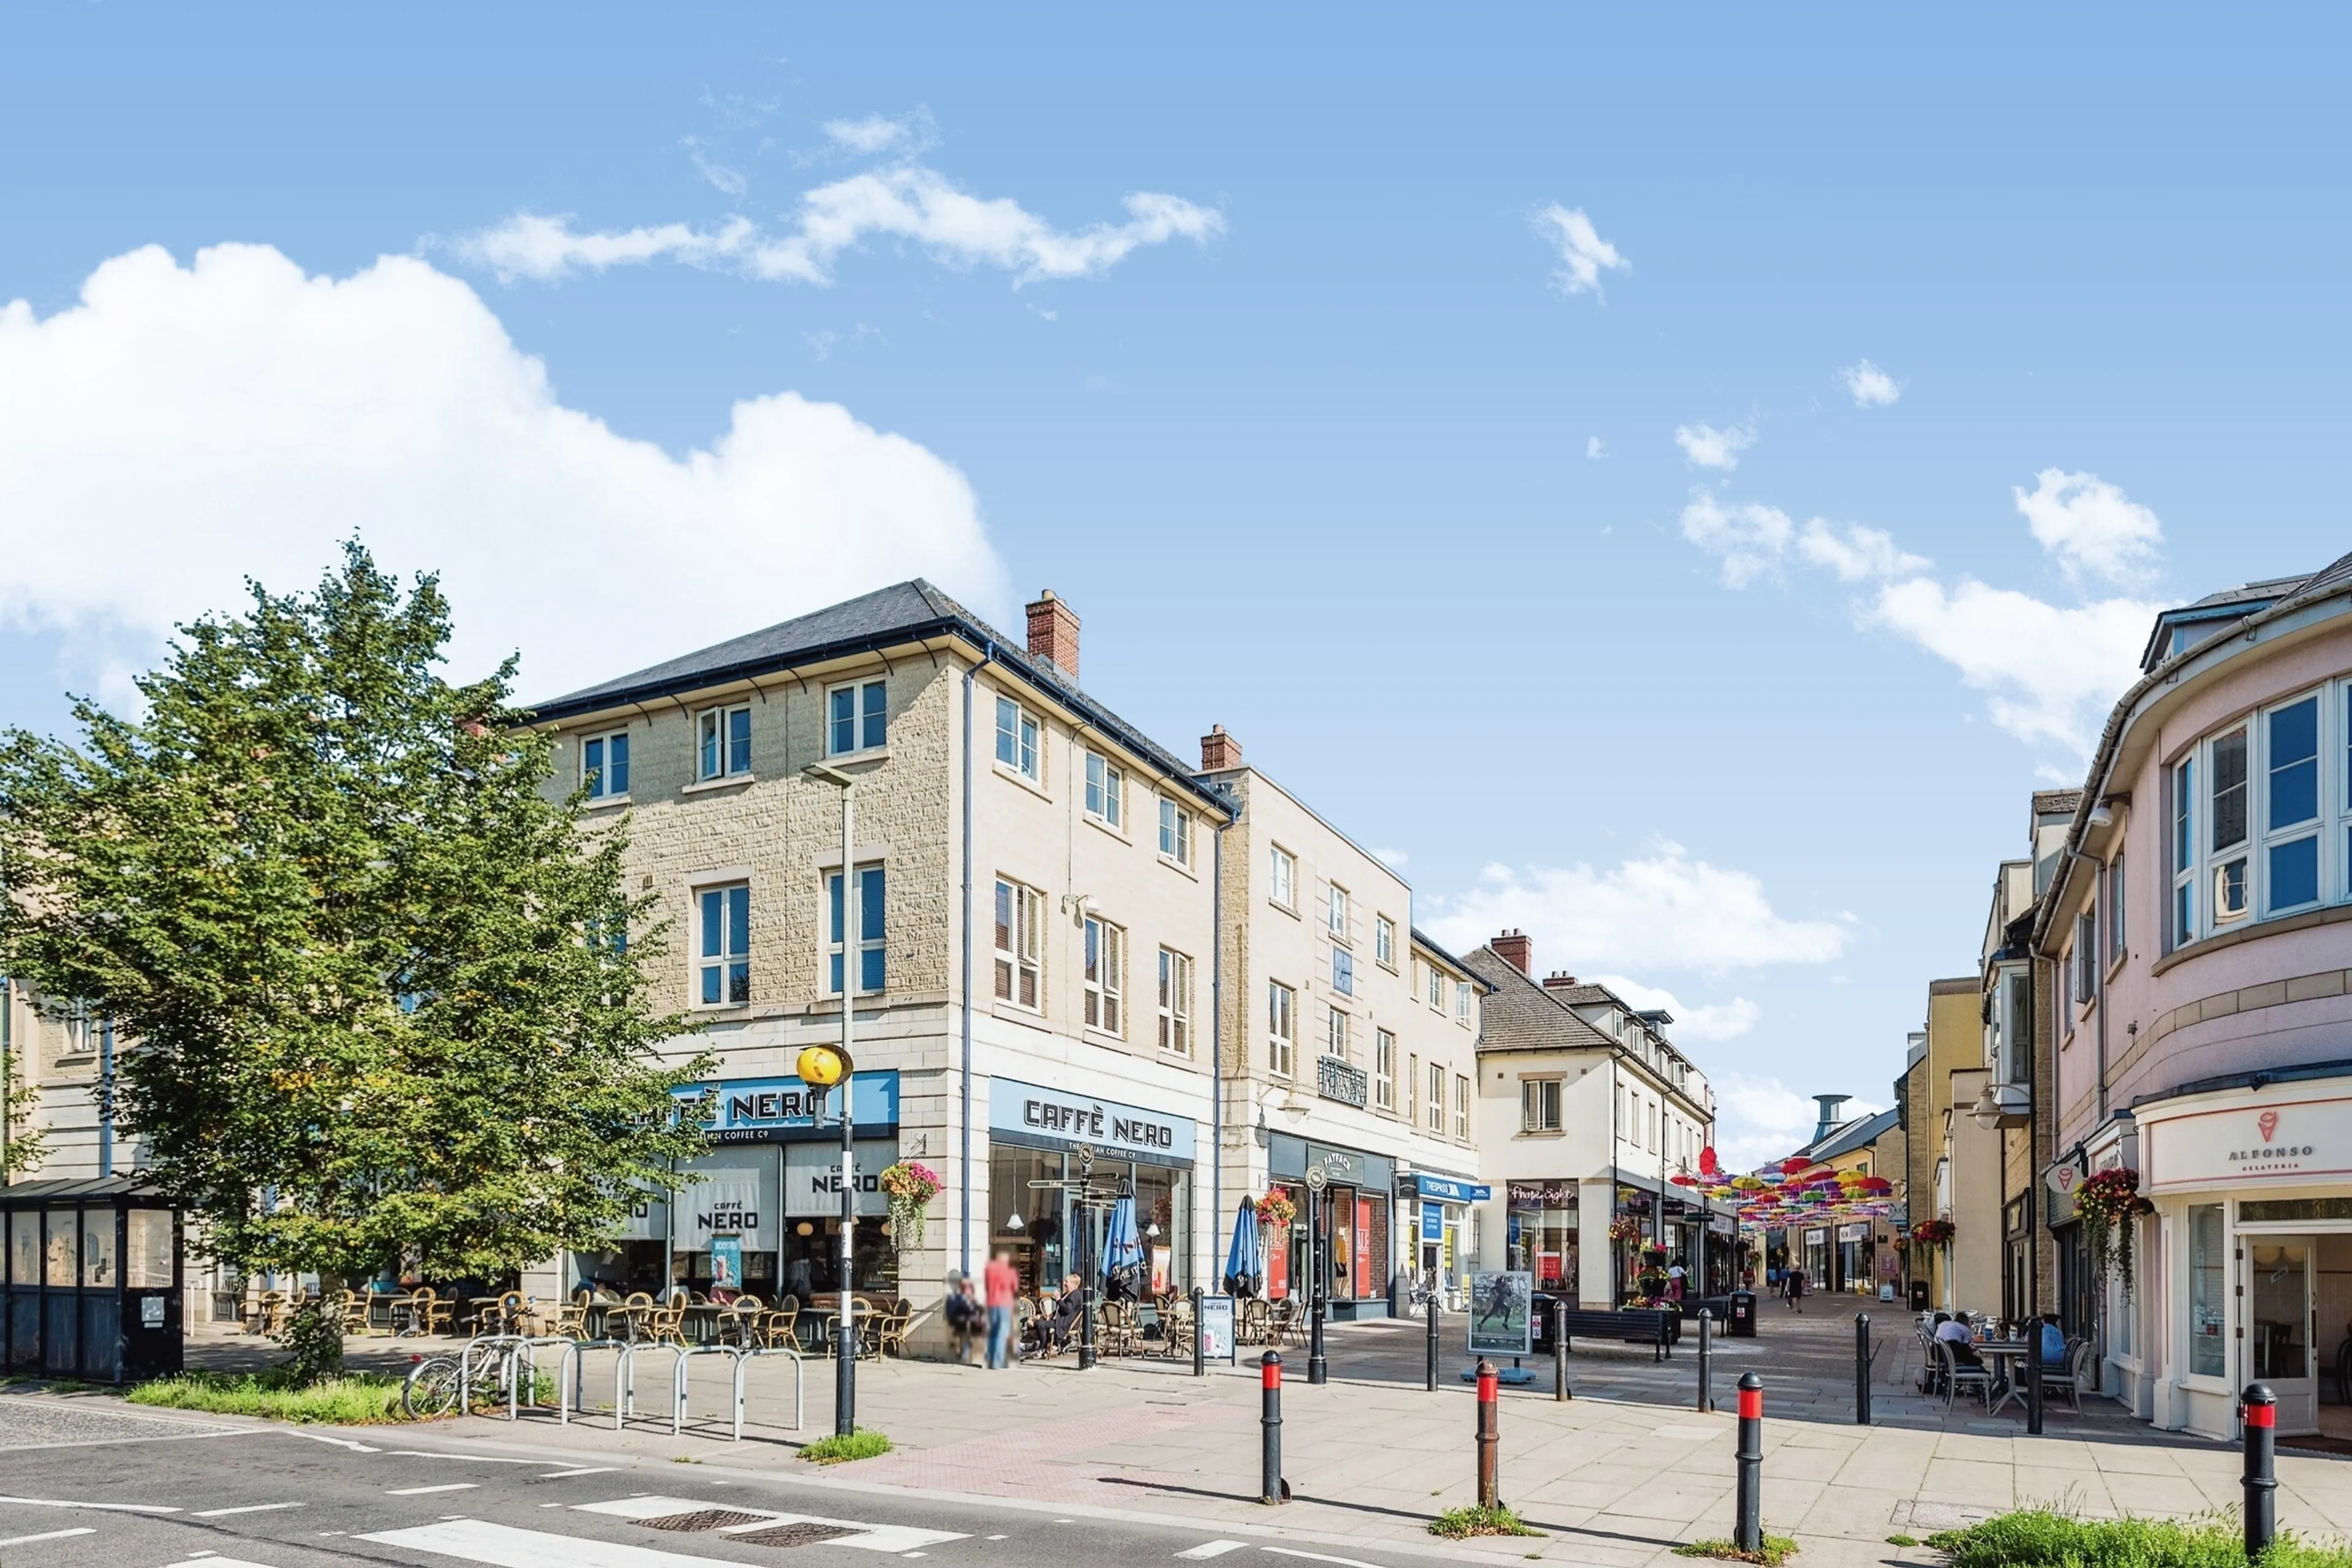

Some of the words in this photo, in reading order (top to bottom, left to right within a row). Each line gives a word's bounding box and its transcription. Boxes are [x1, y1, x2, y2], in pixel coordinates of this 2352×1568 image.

[731, 1091, 826, 1121] NERO
[1024, 1099, 1104, 1137] CAFFÈ
[1114, 1115, 1172, 1149] NERO
[725, 1131, 754, 1139] COFFEE
[1106, 1147, 1127, 1158] COFFEE
[2228, 1145, 2313, 1161] ALFONSO
[2242, 1163, 2299, 1171] GELATERIA
[1426, 1180, 1449, 1194] TRESPASS
[1512, 1186, 1544, 1200] Phase
[714, 1200, 742, 1210] CAFFÈ
[697, 1212, 758, 1229] NERO
